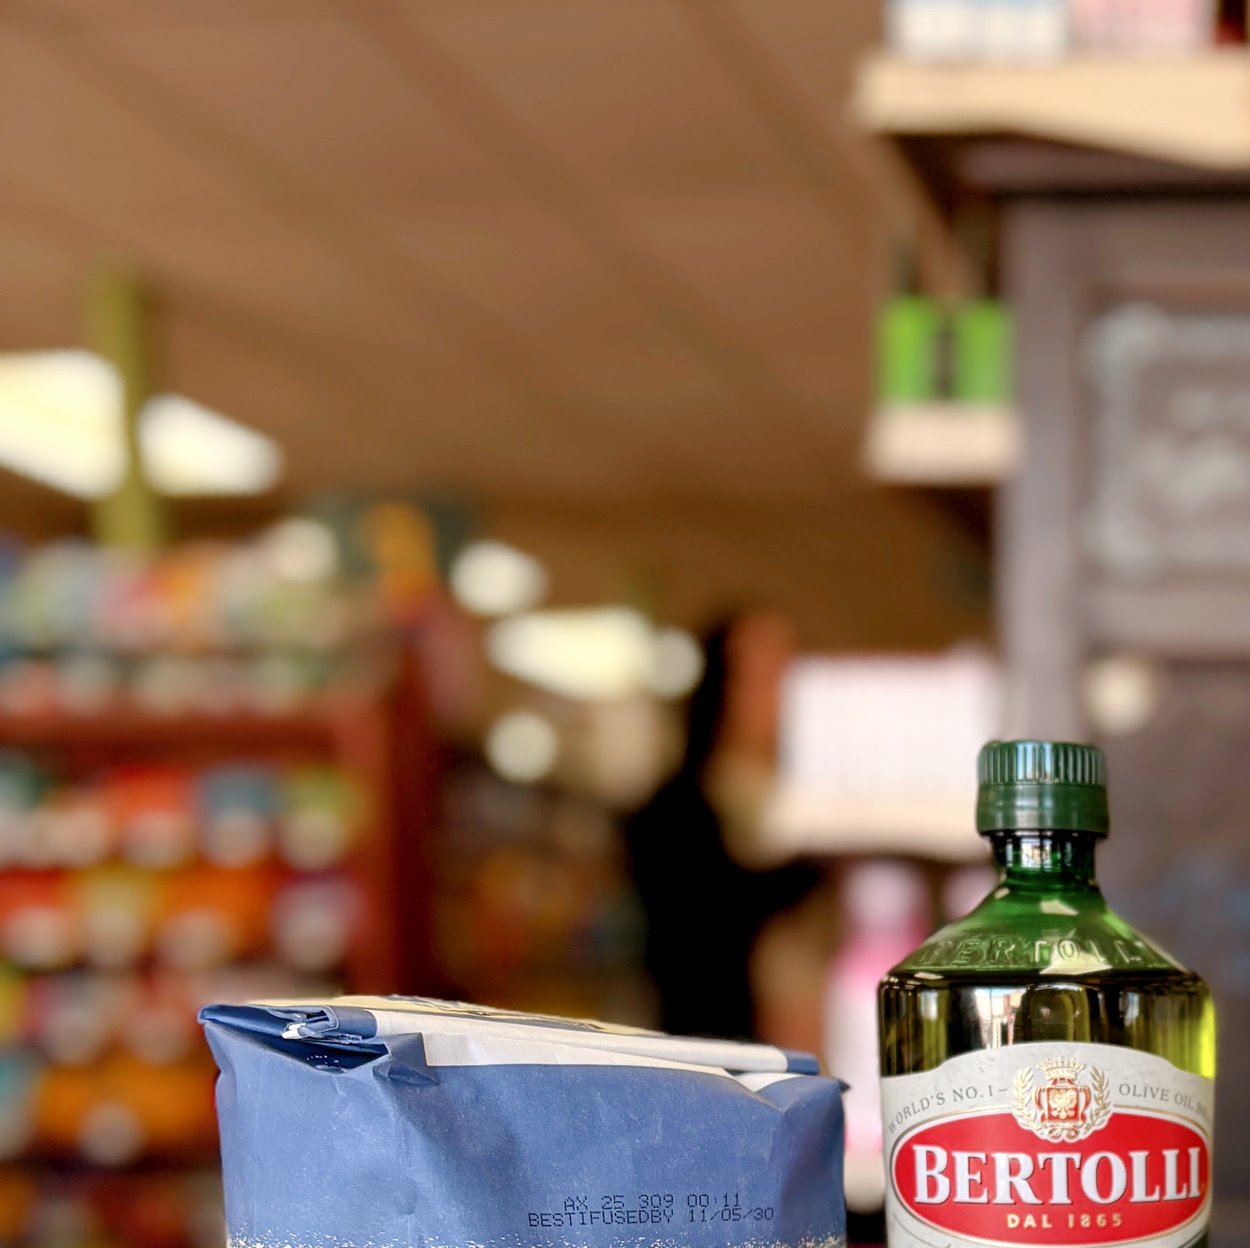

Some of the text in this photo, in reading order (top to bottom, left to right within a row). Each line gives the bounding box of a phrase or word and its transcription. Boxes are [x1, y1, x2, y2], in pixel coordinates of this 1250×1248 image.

[1119, 1083, 1170, 1102] OLIVE
[888, 1092, 945, 1135] WORLD'S
[912, 1144, 1201, 1205] BERTOLLI
[564, 1195, 588, 1211] AX
[601, 1195, 624, 1209] 25
[638, 1194, 674, 1209] 309
[689, 1207, 774, 1223] 11/05/30
[1007, 1213, 1122, 1229] DAL 1865
